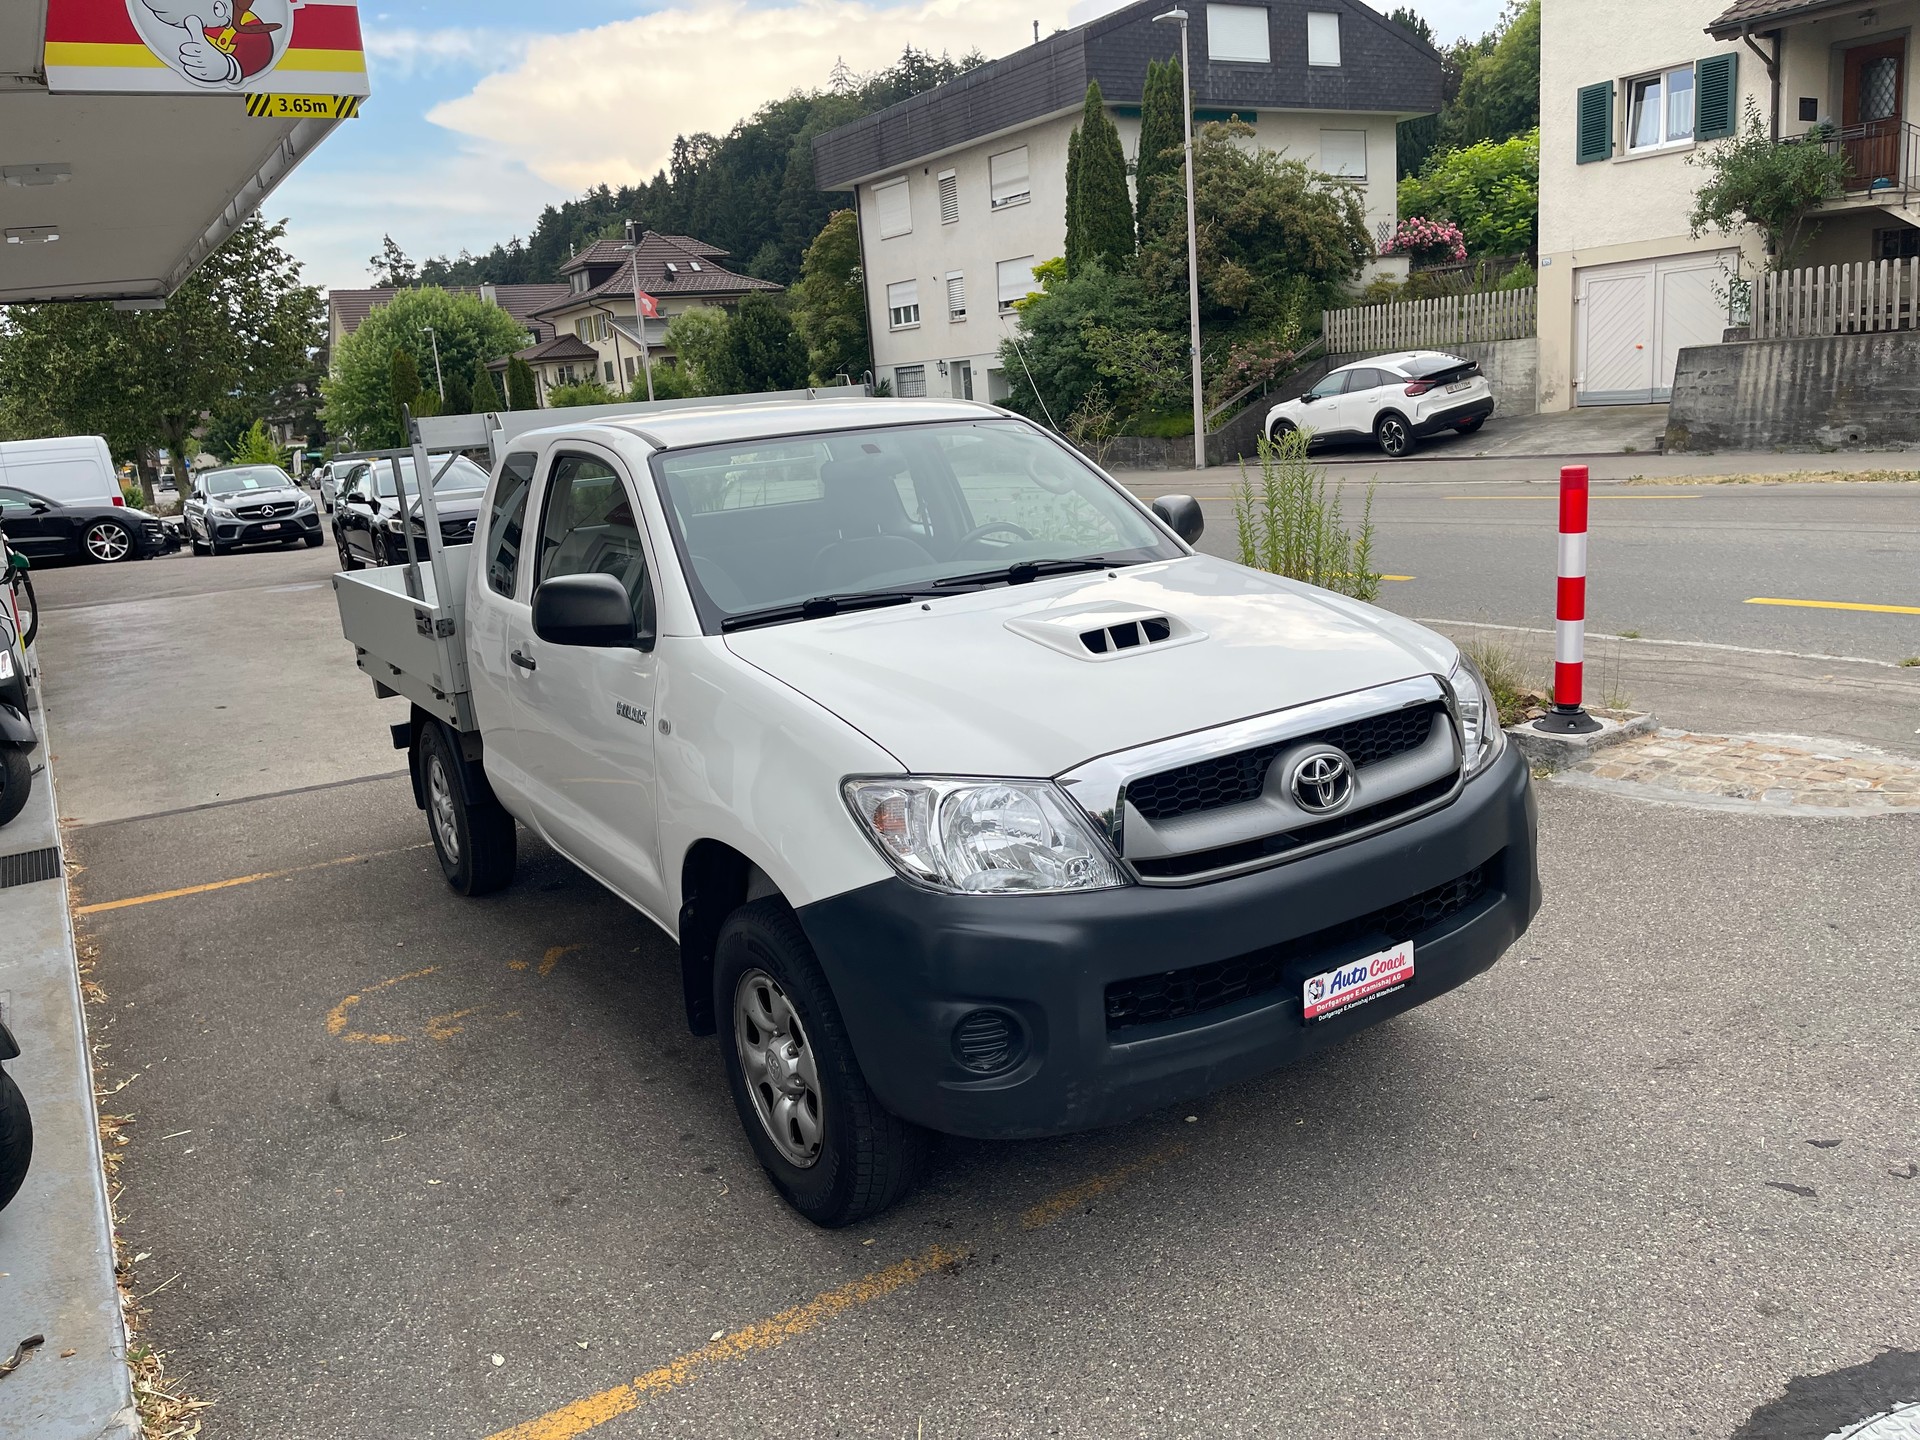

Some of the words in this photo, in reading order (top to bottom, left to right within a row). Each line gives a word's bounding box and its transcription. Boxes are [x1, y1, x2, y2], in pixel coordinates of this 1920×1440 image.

[278, 98, 328, 113] 3.65m
[1330, 967, 1367, 994] Auto
[1370, 952, 1407, 977] Coach
[1316, 993, 1354, 1012] Dorfgarage
[1391, 973, 1402, 983] AG
[1318, 1006, 1344, 1022] Dorfgarage
[1368, 994, 1376, 1002] AG
